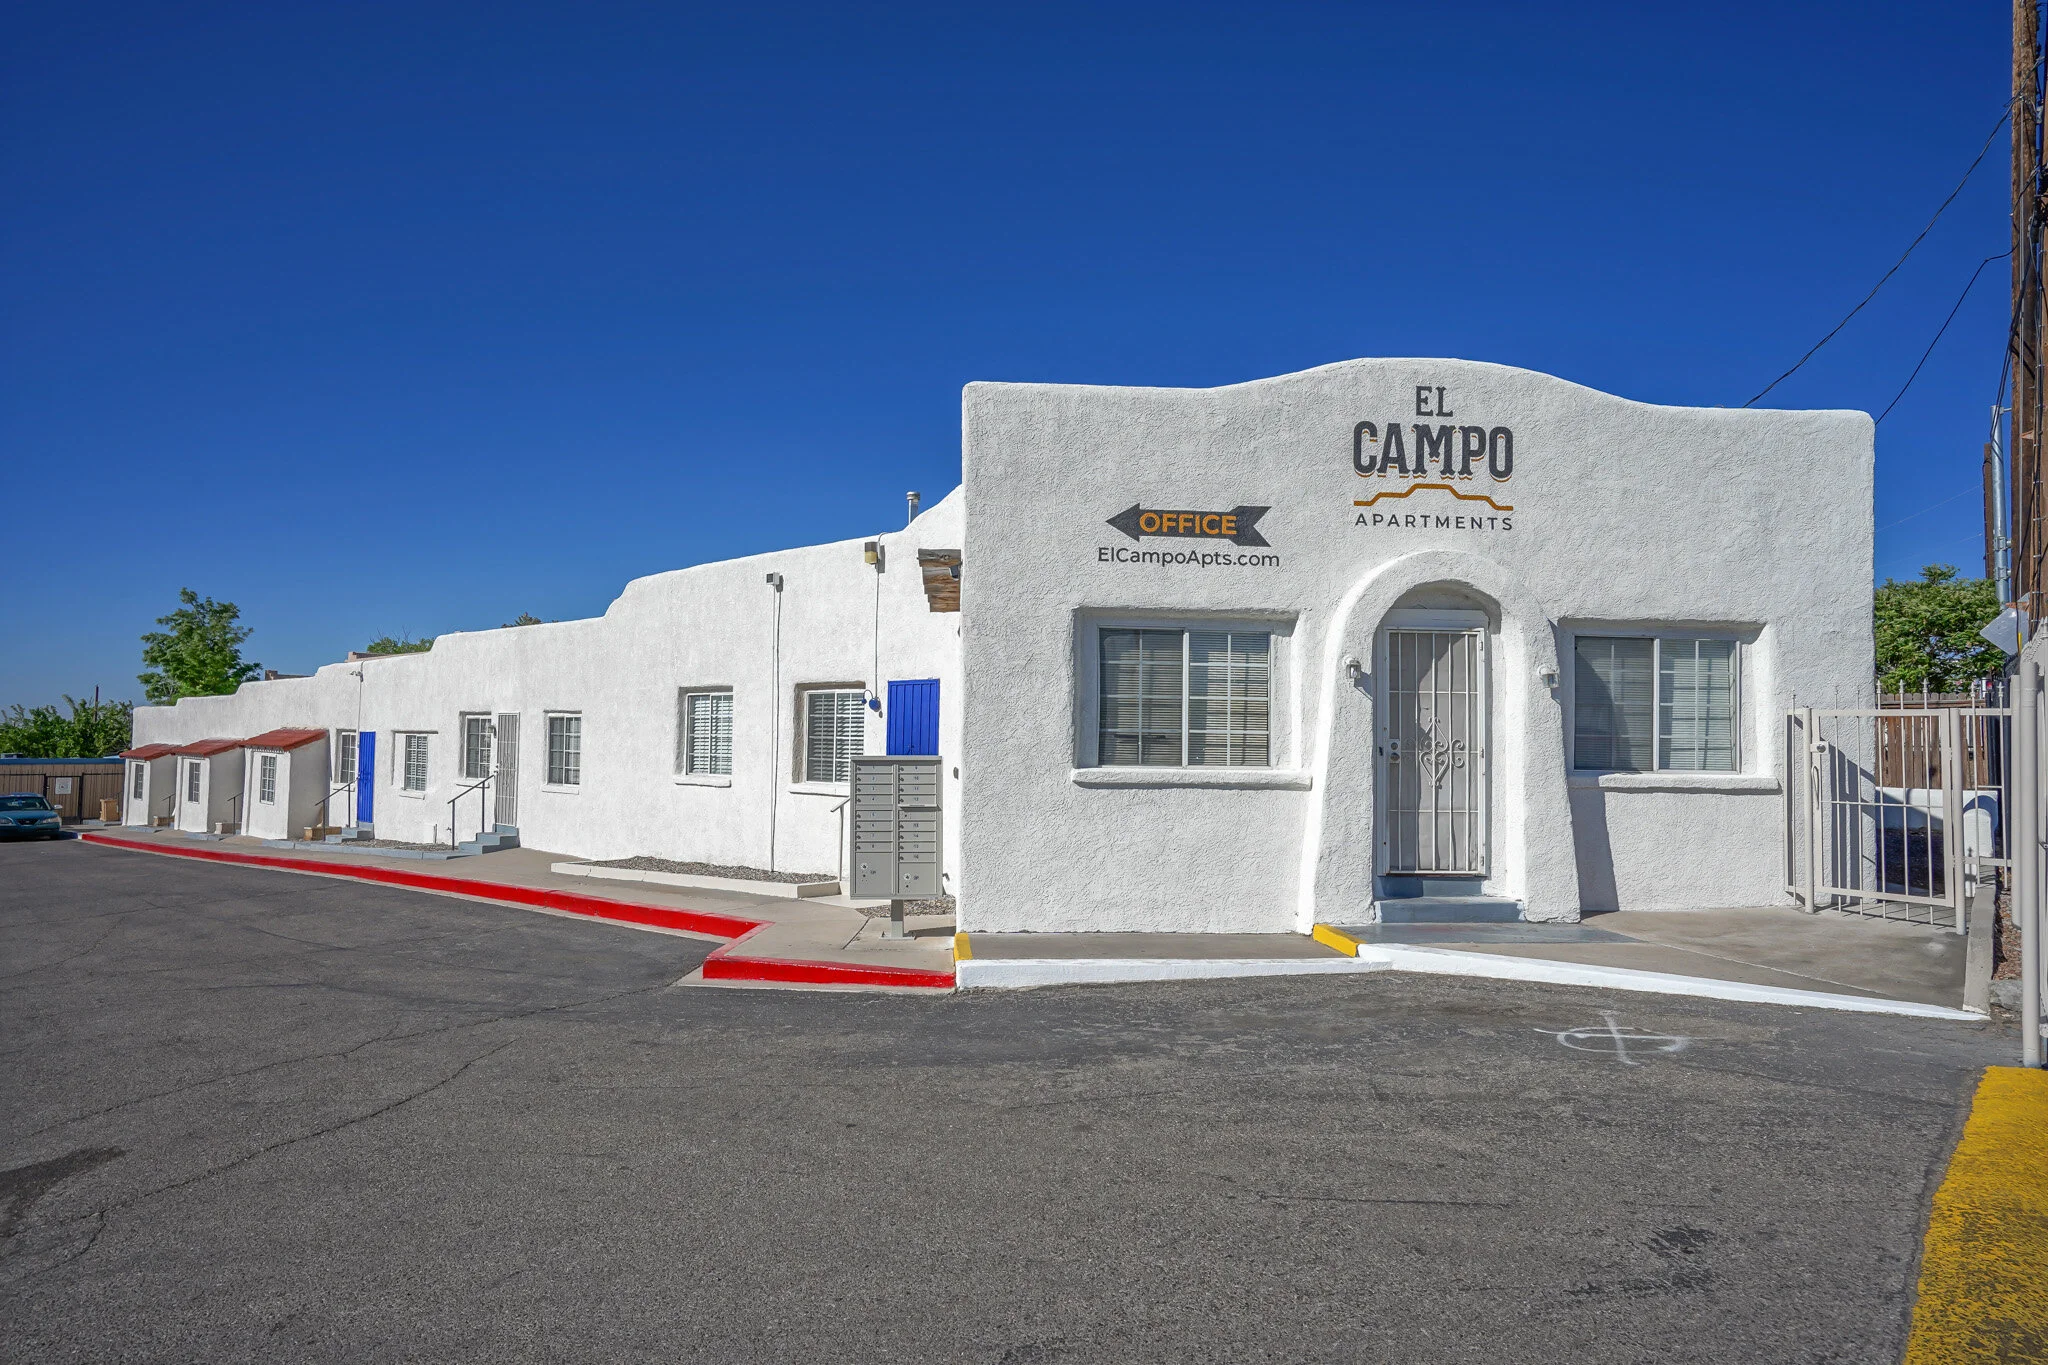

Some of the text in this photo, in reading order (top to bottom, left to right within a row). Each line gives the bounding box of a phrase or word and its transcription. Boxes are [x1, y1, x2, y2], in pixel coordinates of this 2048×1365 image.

[1416, 386, 1453, 417] EL
[1353, 421, 1514, 482] CAMPO
[1139, 512, 1238, 535] OFFICE
[1355, 513, 1513, 531] APARTMENTS
[1097, 547, 1280, 568] ElCampoApts.com
